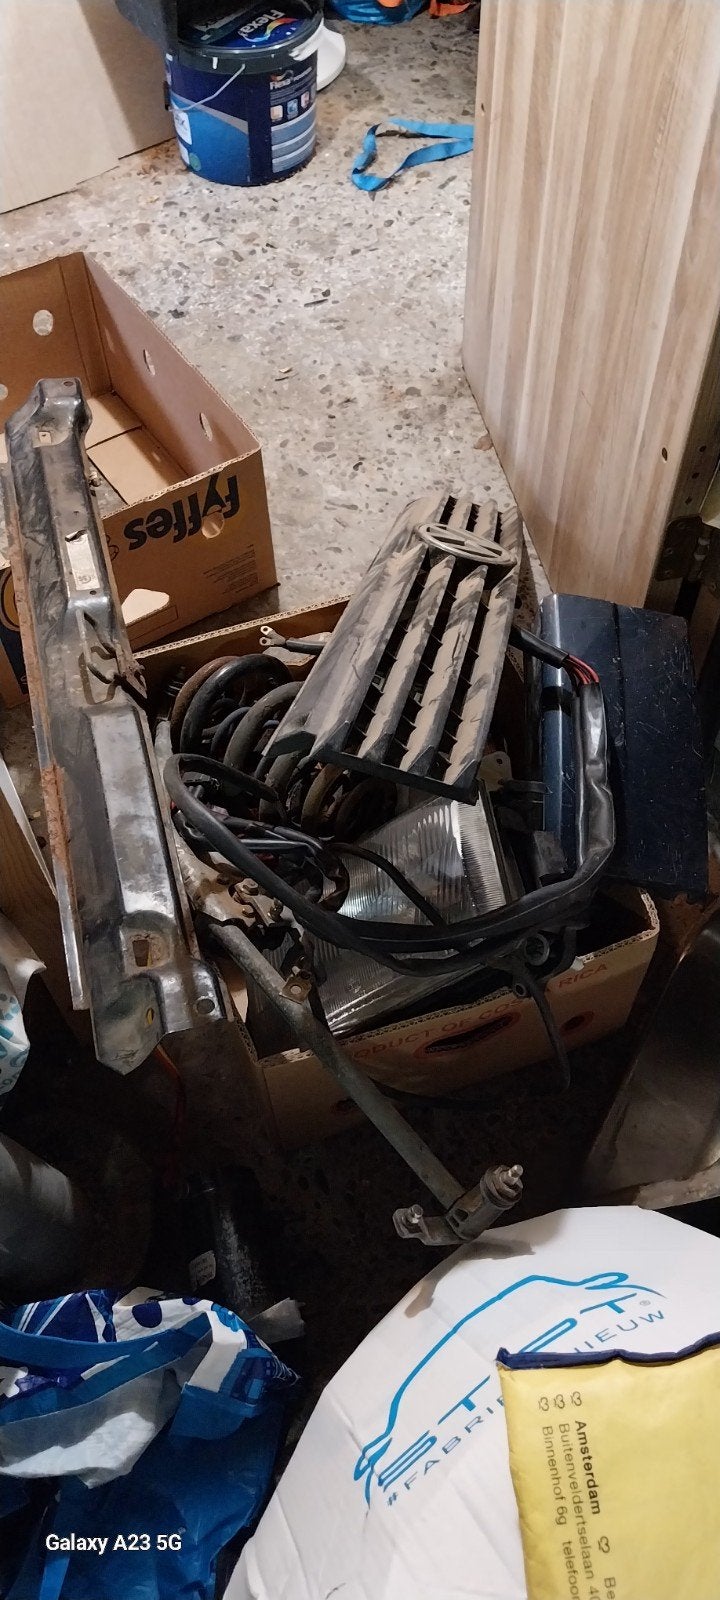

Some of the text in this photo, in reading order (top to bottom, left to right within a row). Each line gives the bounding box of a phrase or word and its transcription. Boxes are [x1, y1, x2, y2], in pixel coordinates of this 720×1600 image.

[352, 1029, 434, 1060] ODUCT
[558, 963, 608, 988] RICA
[541, 1426, 567, 1501] Binnenhof
[554, 1506, 568, 1526] 6g
[558, 1423, 595, 1580] Buitenveldertselaan
[574, 1420, 601, 1515] Amsterdam
